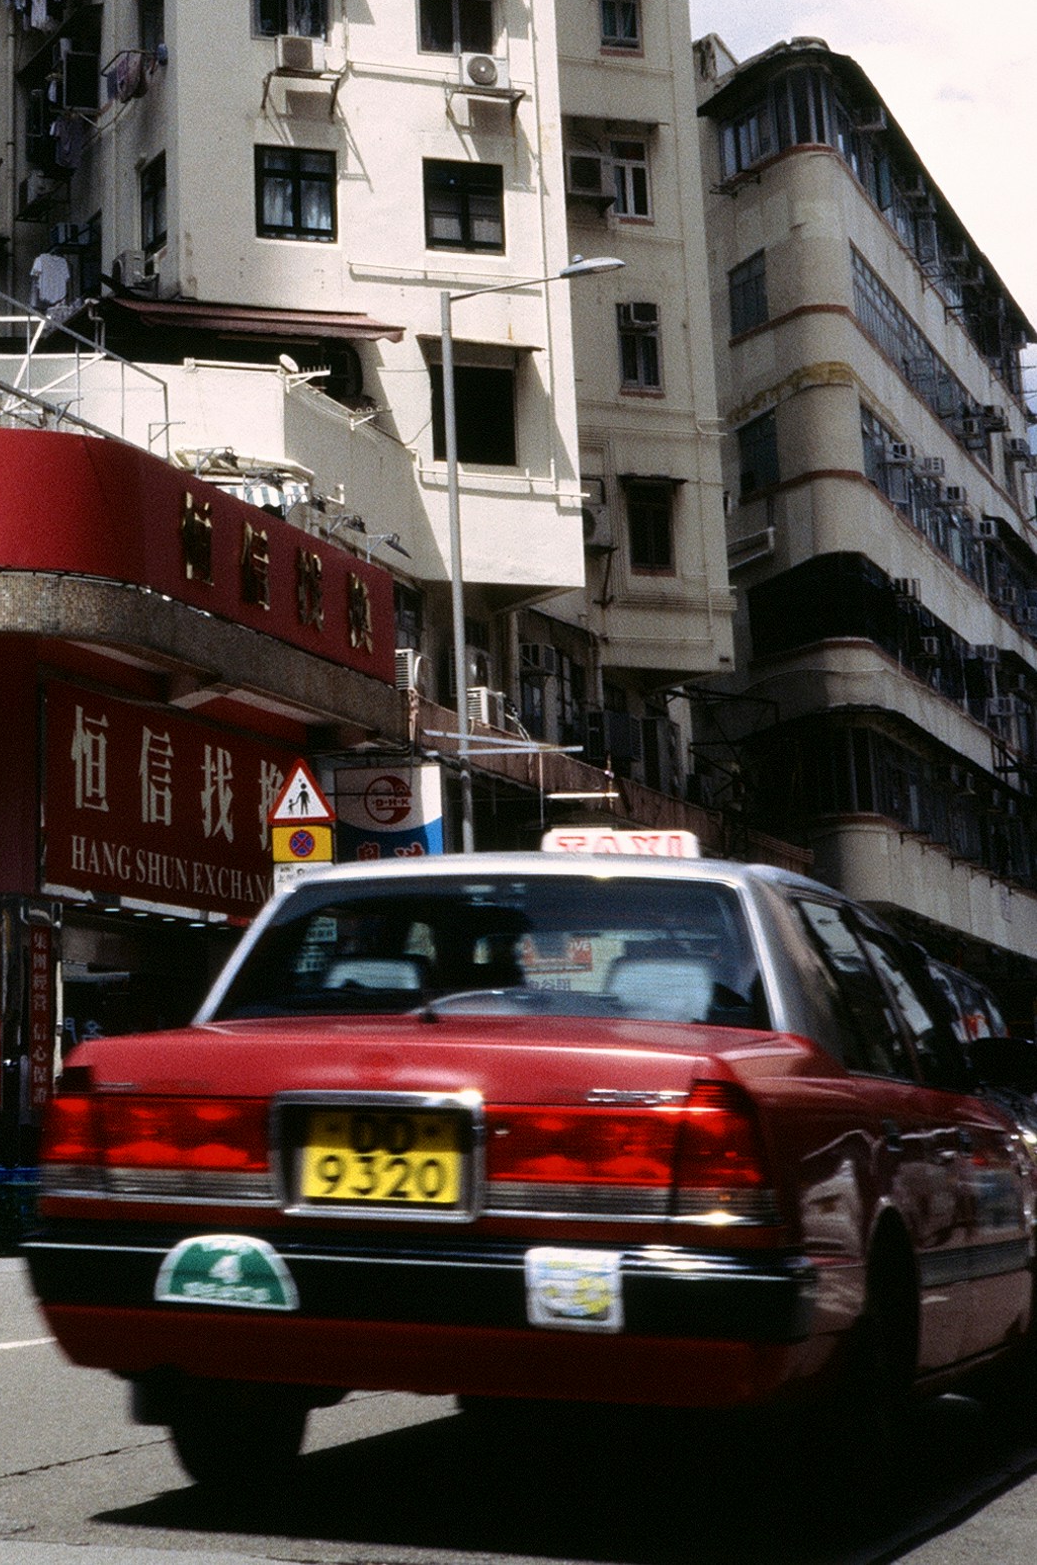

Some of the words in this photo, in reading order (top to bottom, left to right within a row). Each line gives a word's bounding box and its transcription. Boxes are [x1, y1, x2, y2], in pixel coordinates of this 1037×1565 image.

[556, 835, 684, 857] TAXI
[71, 835, 132, 881] HANG
[136, 848, 189, 893] SHUN
[193, 859, 275, 905] EXCHAN
[317, 1154, 449, 1199] 9320
